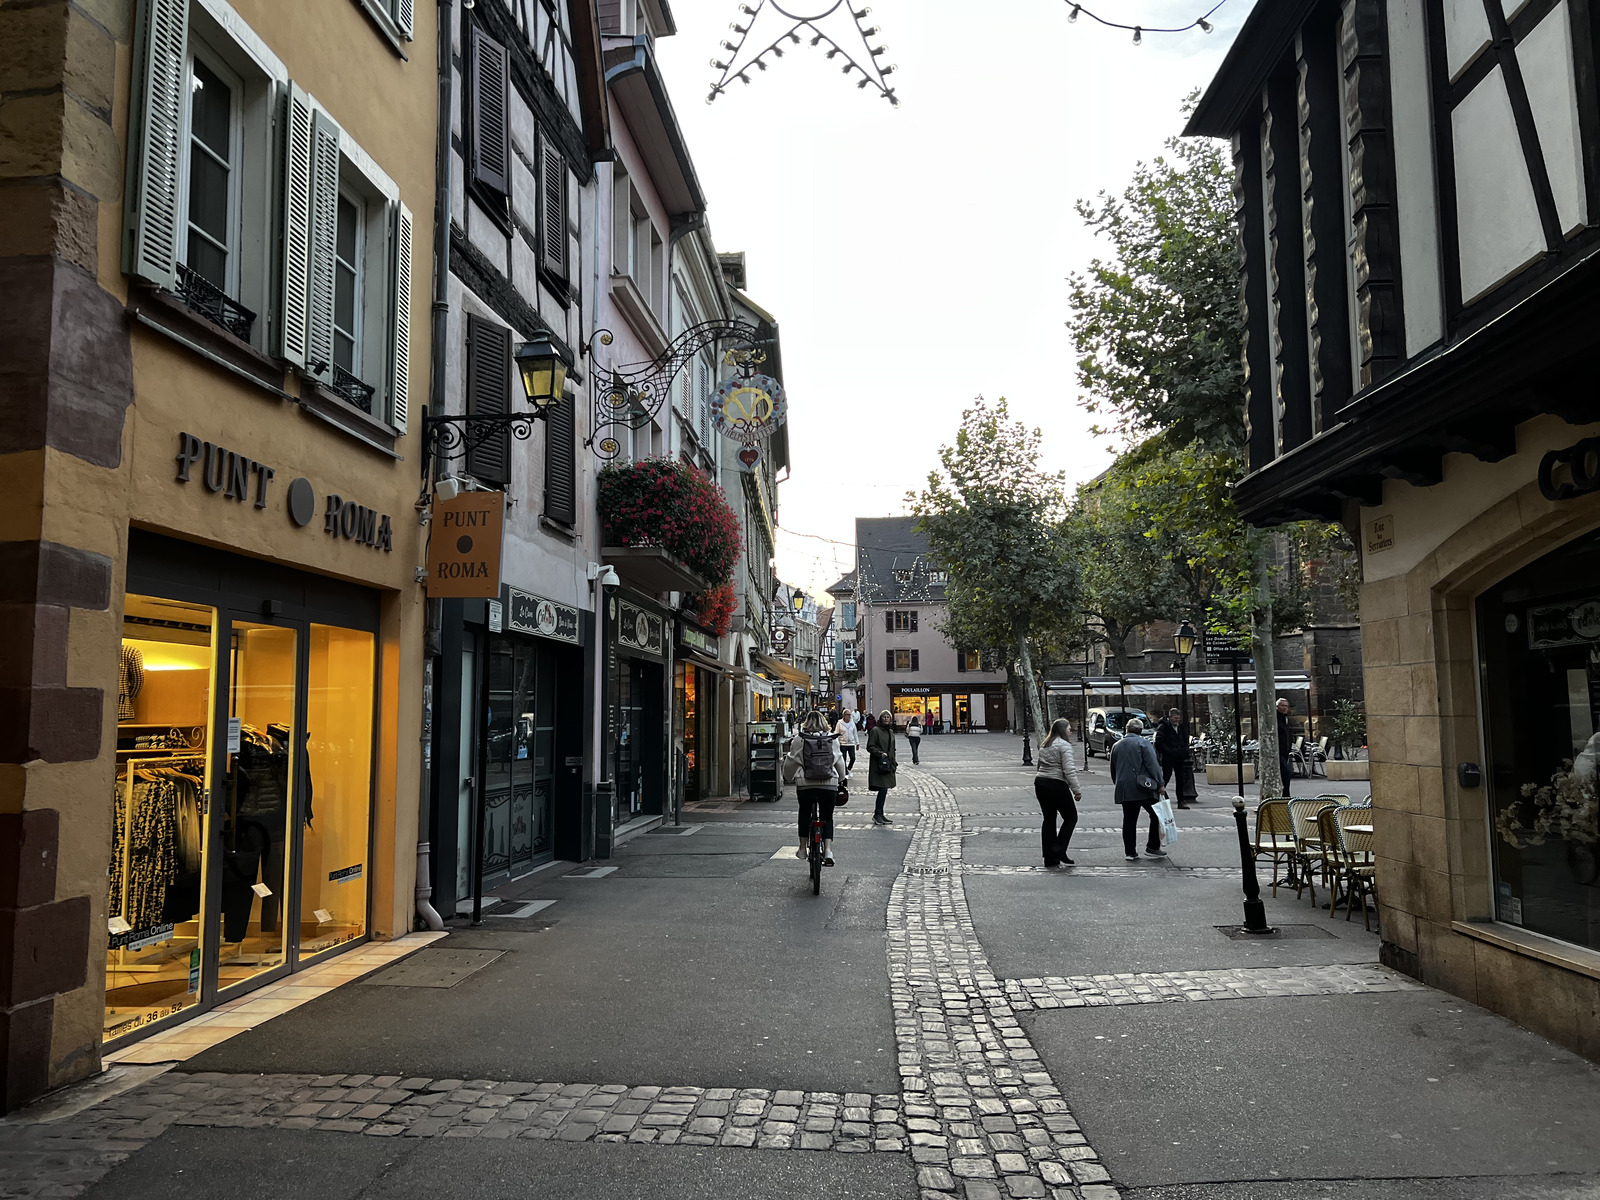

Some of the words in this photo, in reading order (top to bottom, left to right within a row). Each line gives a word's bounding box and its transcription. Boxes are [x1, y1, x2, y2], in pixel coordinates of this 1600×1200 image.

[175, 432, 275, 509] PUNT
[324, 494, 393, 552] ROMA
[443, 510, 490, 527] PUNT
[437, 561, 489, 579] ROMA
[111, 935, 128, 947] Punt
[129, 930, 150, 944] Roma
[150, 922, 174, 936] Online
[146, 1010, 158, 1023] 36
[159, 1007, 169, 1018] au
[171, 1001, 183, 1014] 52
